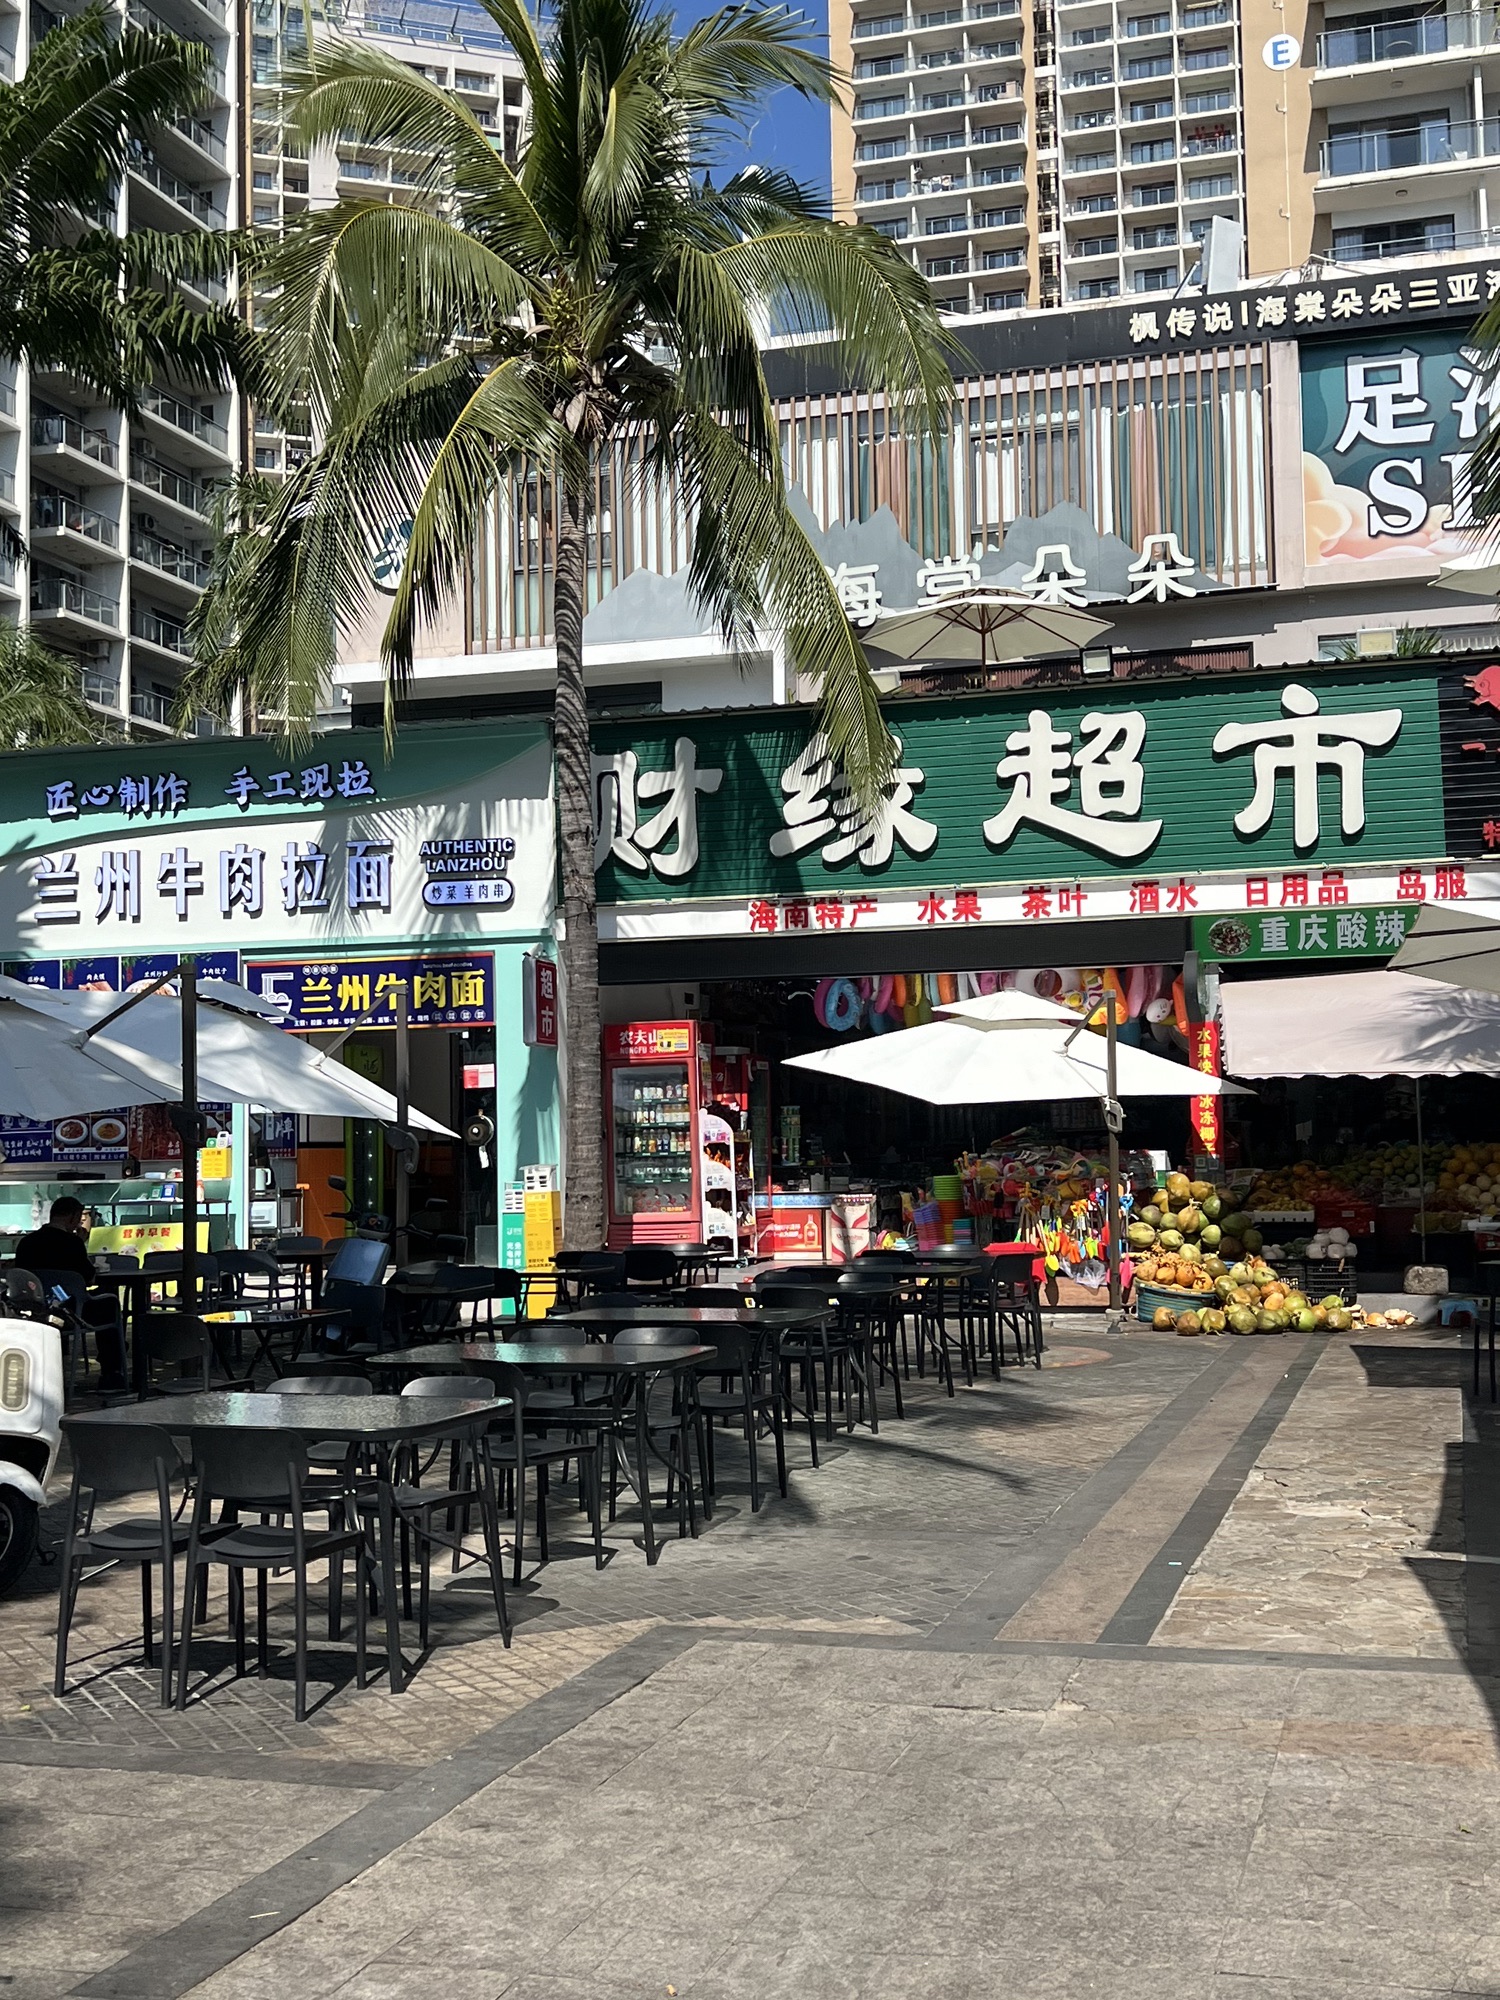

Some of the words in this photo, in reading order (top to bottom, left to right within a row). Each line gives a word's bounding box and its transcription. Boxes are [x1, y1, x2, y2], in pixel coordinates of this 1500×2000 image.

[1272, 40, 1290, 65] E
[45, 772, 189, 819] 匠心制作
[224, 760, 376, 806] 手工现拉
[590, 683, 1402, 876] 财缘超市
[420, 838, 514, 855] AUTHENTIC
[426, 857, 506, 873] LANZHOU
[34, 839, 393, 922] 兰州牛肉拉面
[750, 895, 878, 933] 海南特产
[917, 889, 983, 925] 水果
[1022, 884, 1088, 919] 茶叶
[1130, 878, 1199, 914] 酒水
[1246, 870, 1349, 907] 日用品
[1397, 866, 1468, 900] 岛服
[1259, 912, 1418, 952] 重庆酸辣
[300, 968, 486, 1013] 兰州牛肉面
[541, 968, 554, 1037] 超市
[619, 1028, 664, 1045] 农夫山
